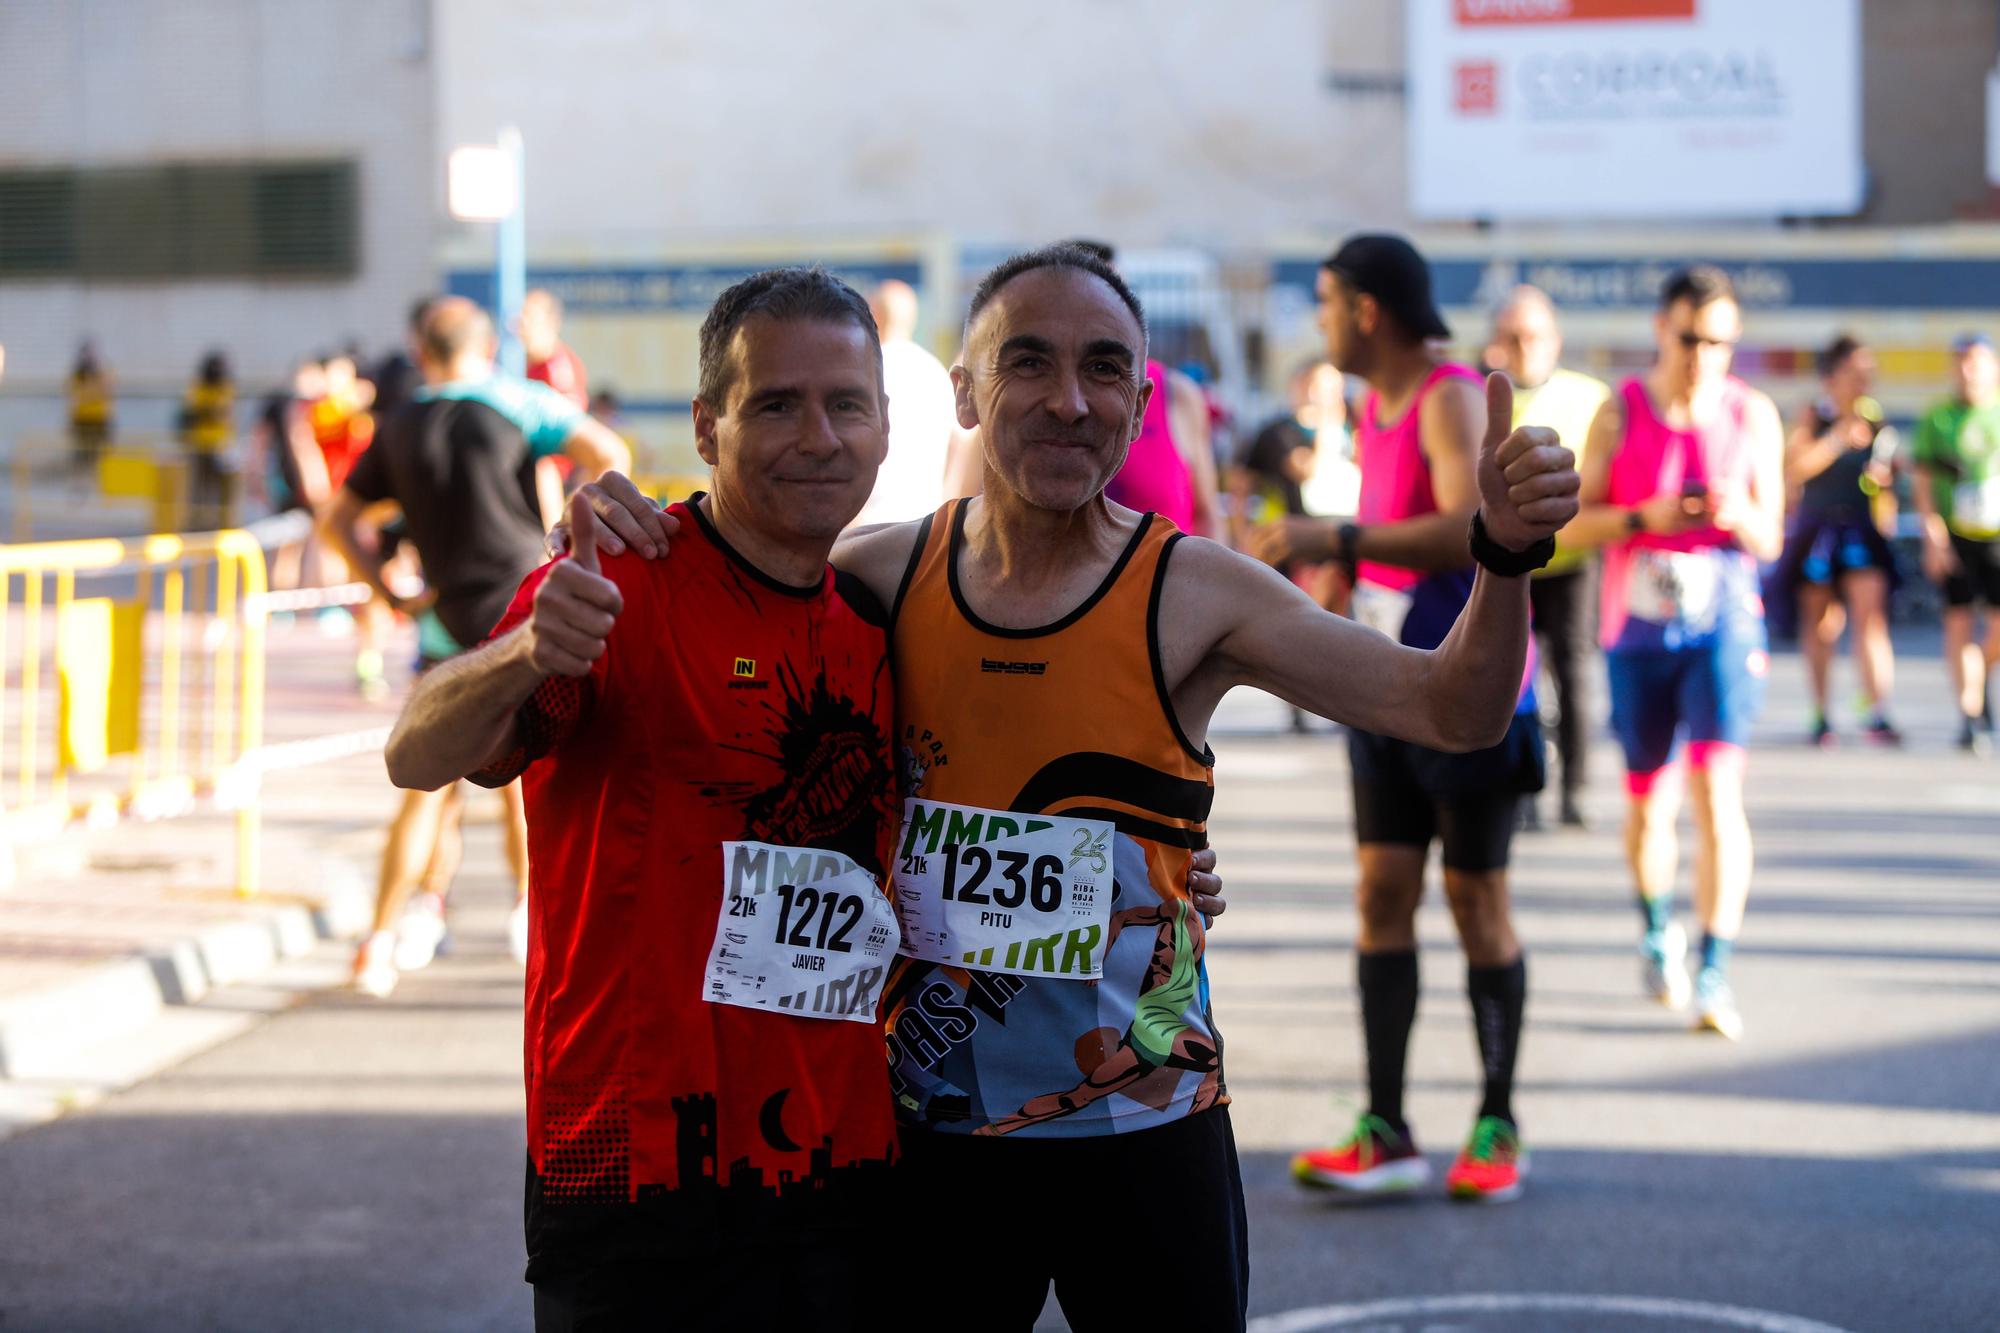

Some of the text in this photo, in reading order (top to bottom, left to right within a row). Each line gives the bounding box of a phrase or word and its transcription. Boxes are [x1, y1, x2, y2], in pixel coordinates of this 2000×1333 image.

[736, 661, 753, 674] IN
[941, 844, 1064, 912] 1236
[729, 896, 756, 917] 21k
[775, 885, 864, 953] 1212
[980, 911, 1012, 928] PITU
[792, 953, 825, 972] JAVIER
